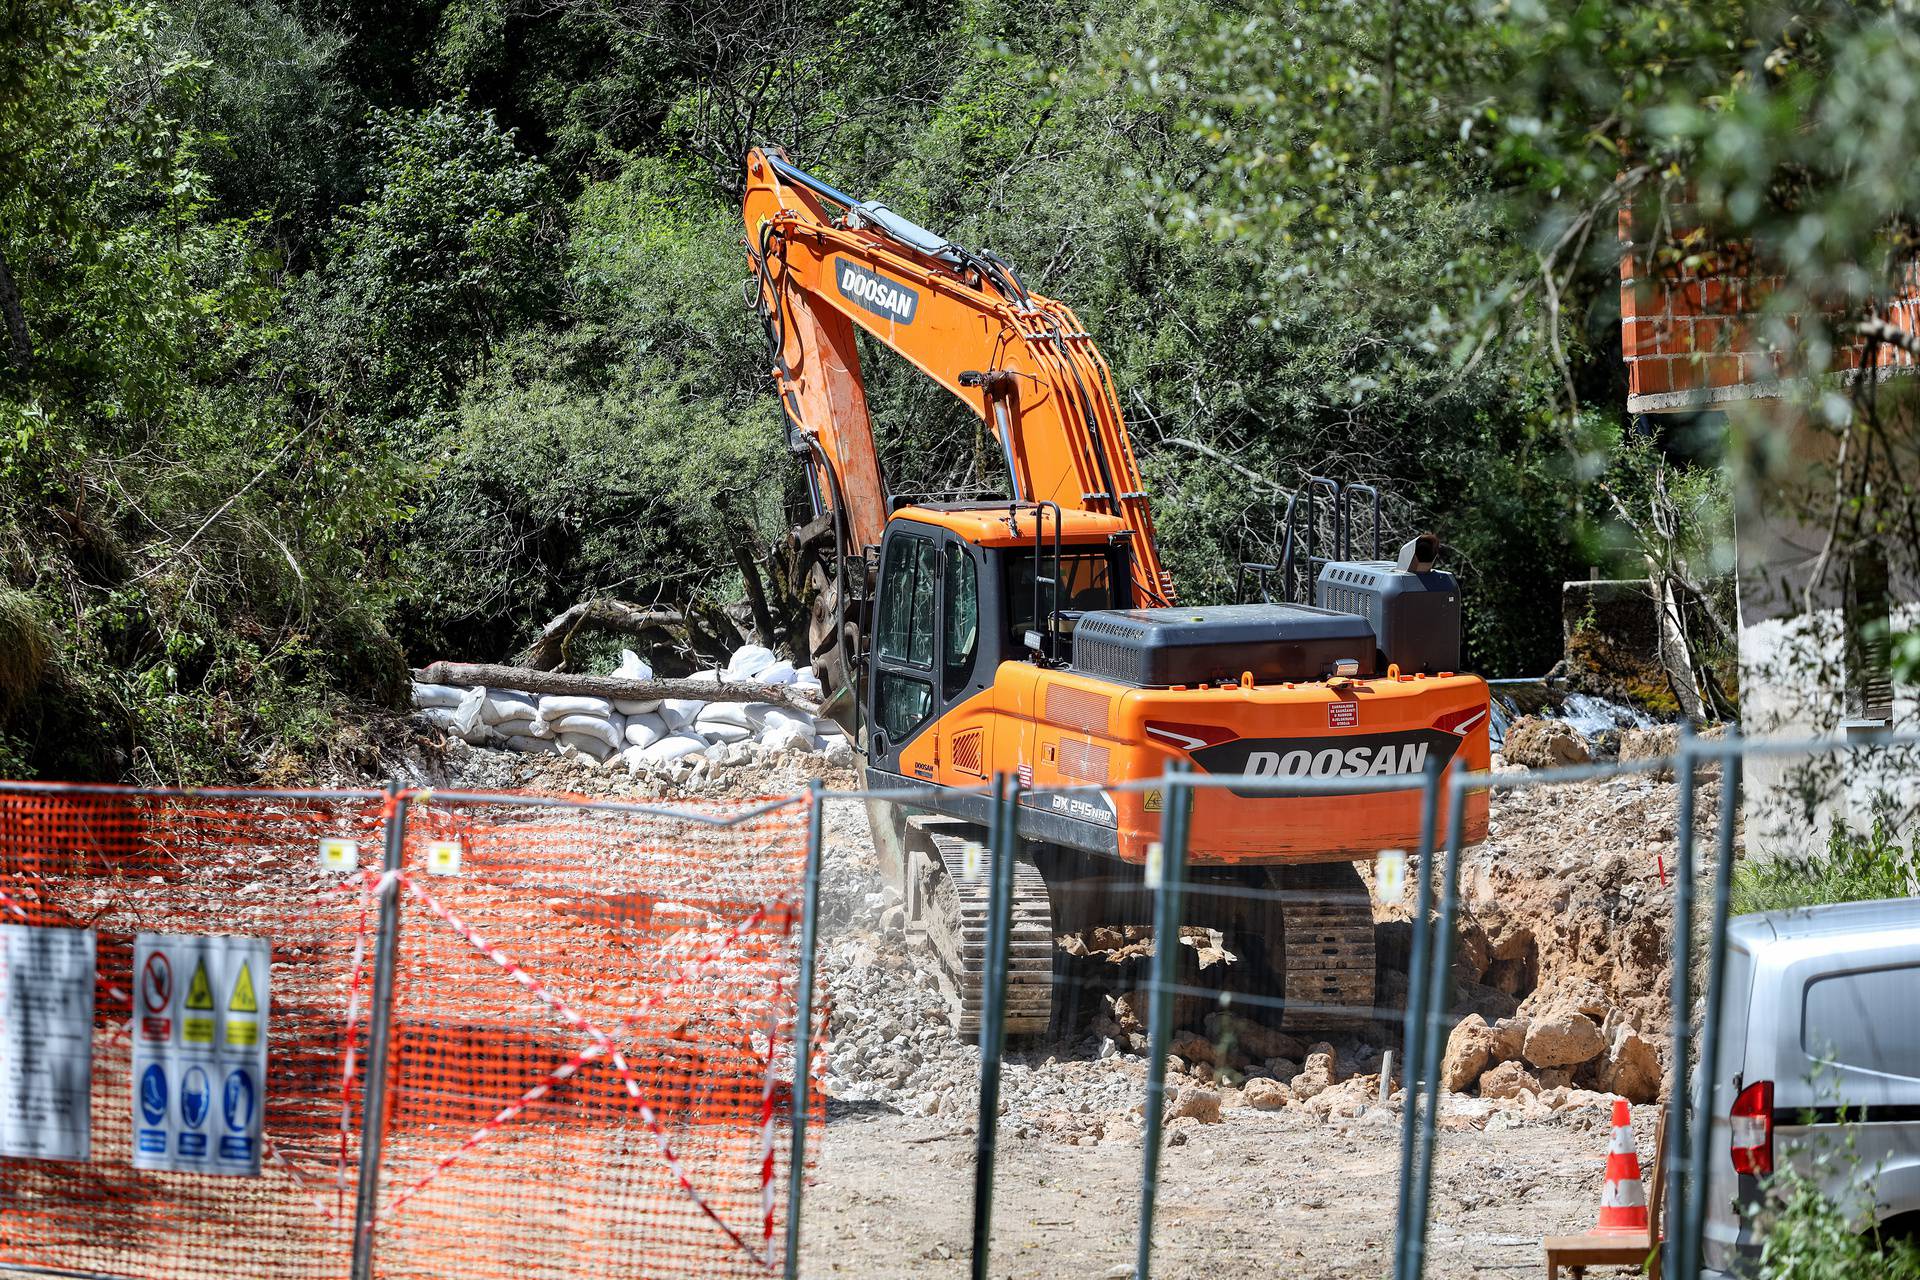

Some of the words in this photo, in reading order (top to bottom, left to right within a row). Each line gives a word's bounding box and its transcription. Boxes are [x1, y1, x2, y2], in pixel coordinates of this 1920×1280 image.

[841, 268, 912, 318] DOOSAN
[1242, 742, 1429, 780] DOOSAN
[1052, 794, 1069, 813] DX
